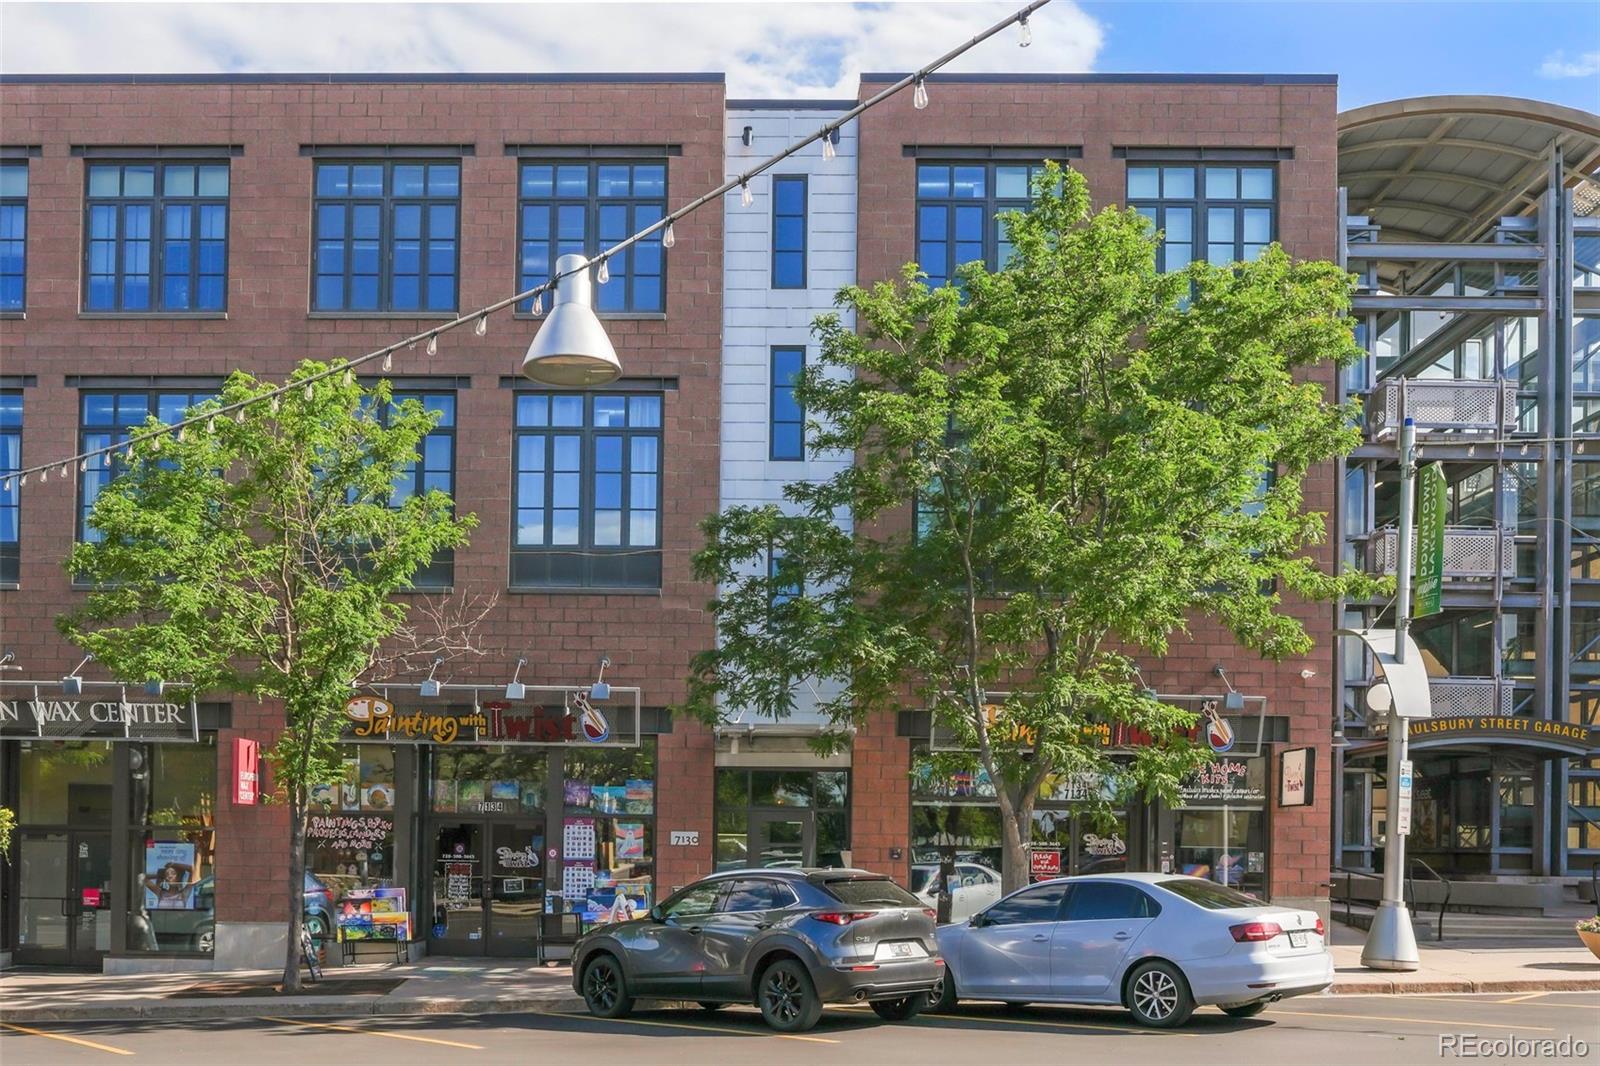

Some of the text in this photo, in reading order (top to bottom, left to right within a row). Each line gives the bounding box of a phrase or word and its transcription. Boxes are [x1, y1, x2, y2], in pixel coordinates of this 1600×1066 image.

[1420, 473, 1431, 577] DOWNTOWN
[1428, 465, 1437, 575] LAKEWOOD
[28, 701, 82, 723] WAX
[89, 702, 186, 724] CENTER
[347, 697, 577, 744] Painting with a Twist
[1408, 718, 1588, 741] AULSBURY STREET GARAGE
[1201, 773, 1228, 785] KITS
[1211, 762, 1247, 777] HOME
[1064, 789, 1088, 799] 7134
[478, 802, 503, 813] 7134
[674, 835, 700, 847] 7130
